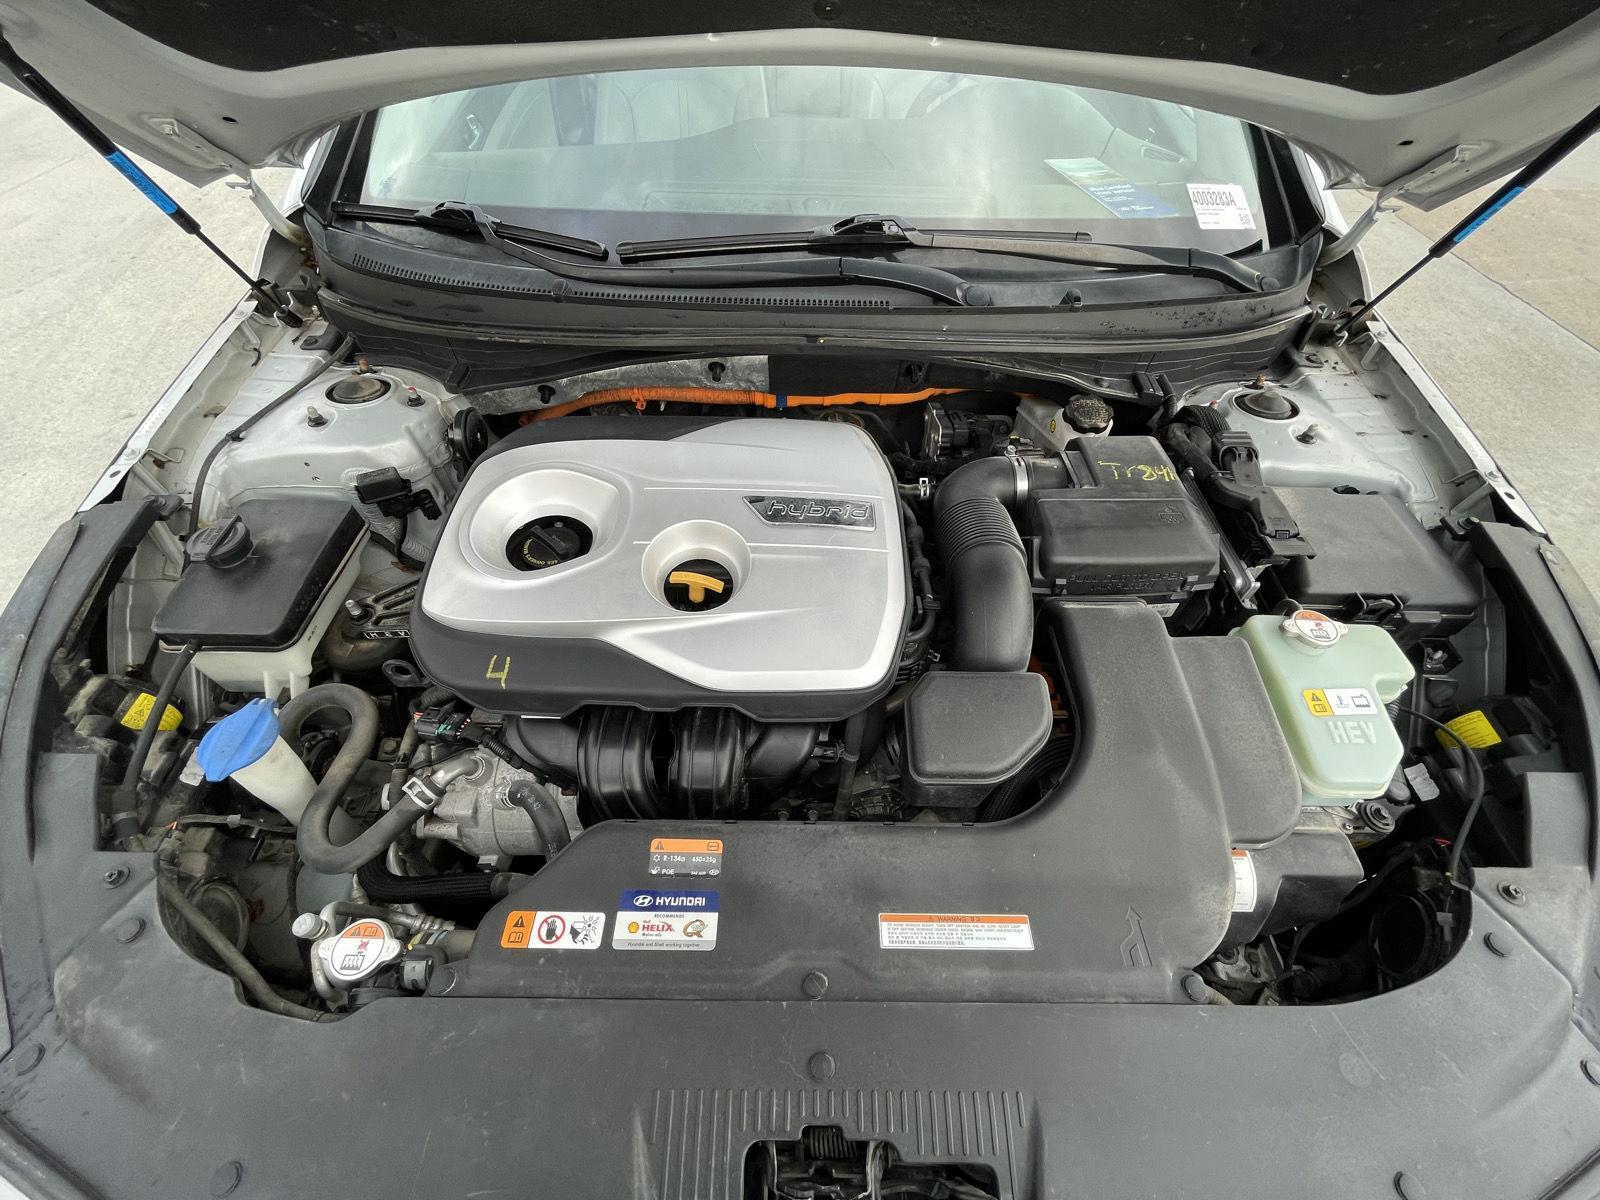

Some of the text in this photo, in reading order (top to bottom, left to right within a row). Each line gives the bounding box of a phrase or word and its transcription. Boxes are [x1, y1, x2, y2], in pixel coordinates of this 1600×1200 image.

[1192, 190, 1237, 206] 4003283A
[767, 500, 869, 520] hybrid
[486, 654, 511, 689] 4
[1327, 720, 1377, 744] HEV
[655, 896, 706, 906] HYUNDAI
[641, 924, 674, 932] HELIX
